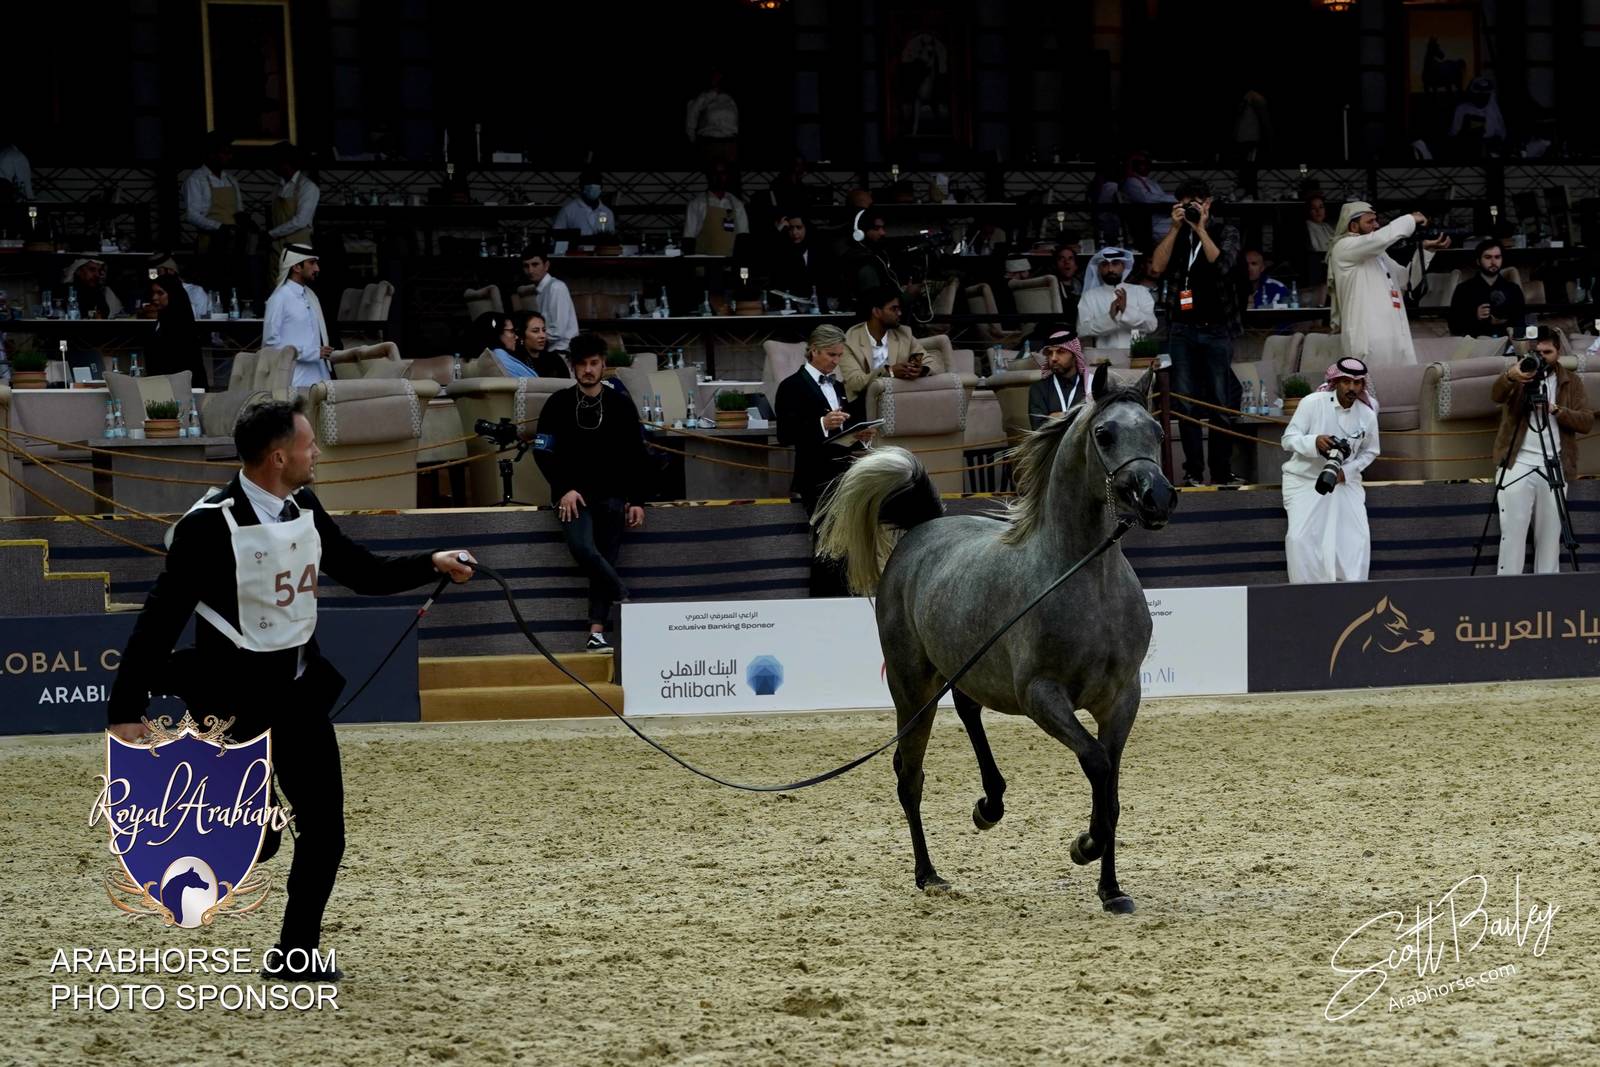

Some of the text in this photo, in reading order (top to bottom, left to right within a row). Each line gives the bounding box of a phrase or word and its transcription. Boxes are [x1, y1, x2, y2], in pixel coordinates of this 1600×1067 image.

[275, 563, 318, 607] 54
[668, 622, 775, 631] Exclusive Banking Sponsor
[1455, 609, 1600, 650] ياد العربية
[660, 659, 737, 683] البنك الأهلي
[38, 684, 111, 705] ARABI
[661, 681, 736, 699] ahlibank
